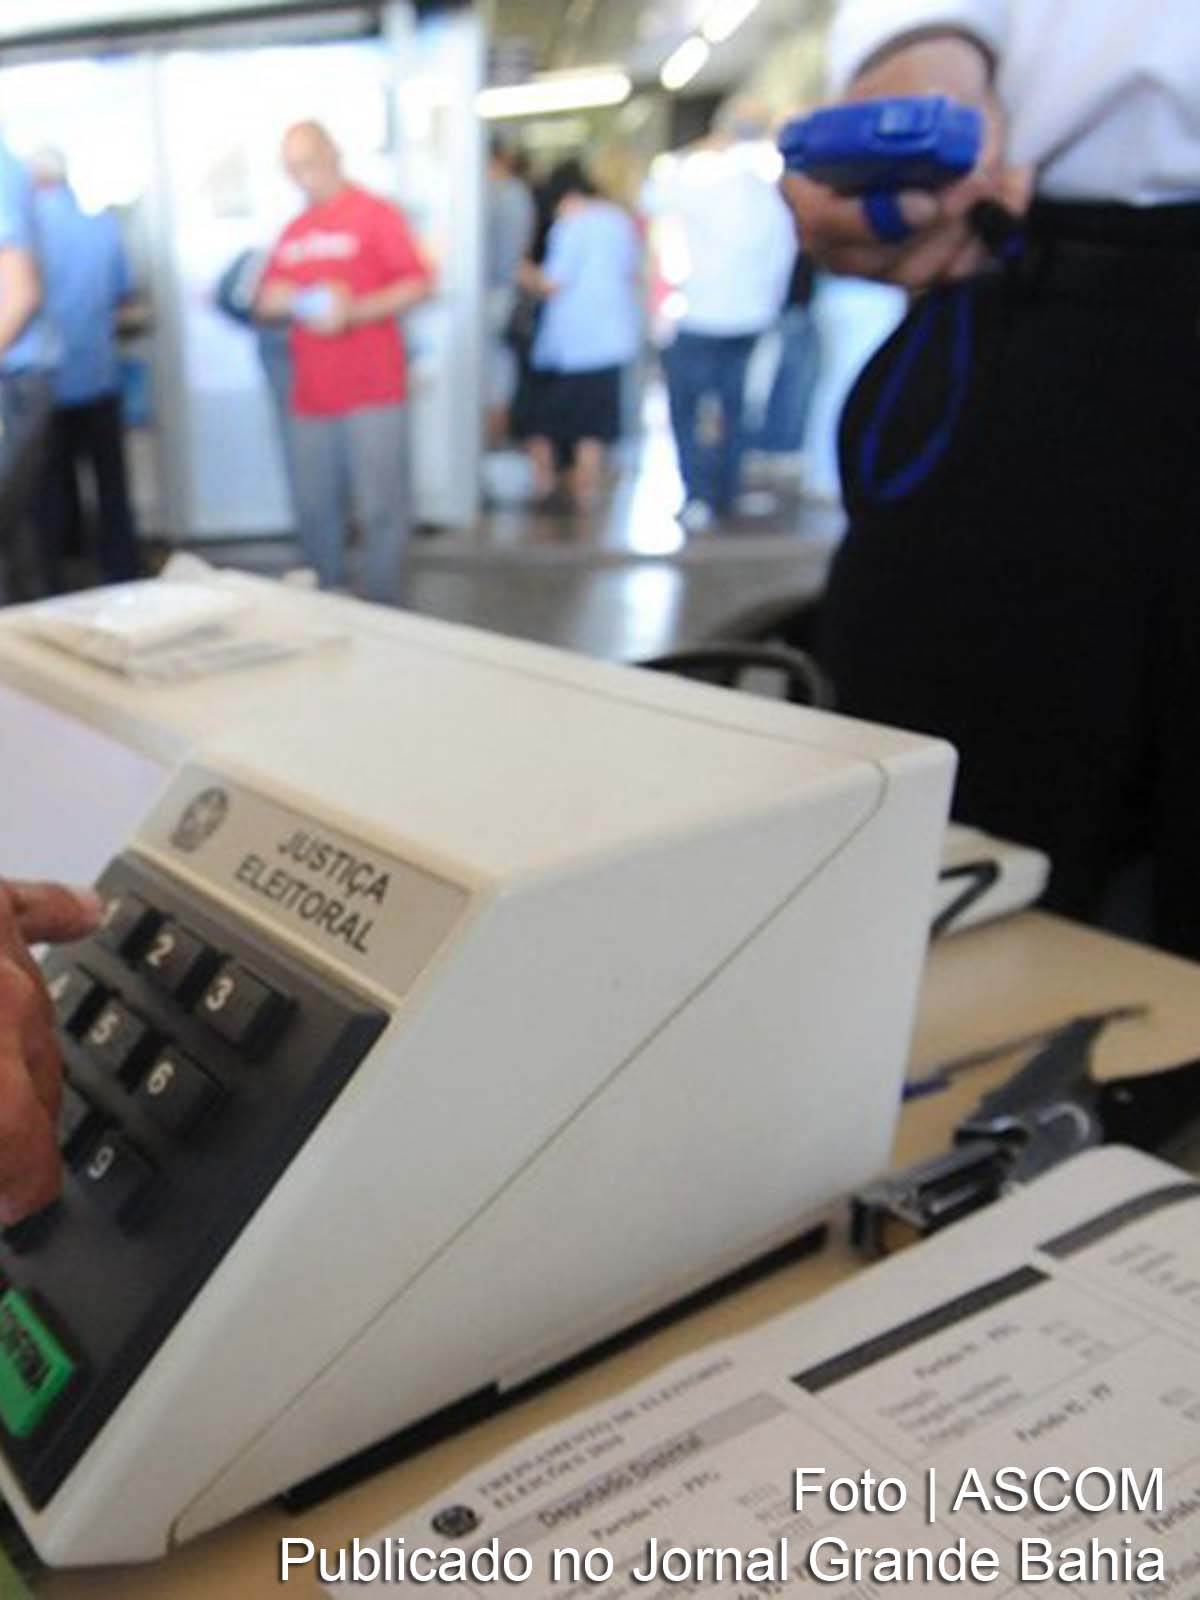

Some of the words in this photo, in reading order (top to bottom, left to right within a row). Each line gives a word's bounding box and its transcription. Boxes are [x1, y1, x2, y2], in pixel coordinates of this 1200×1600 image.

[234, 853, 374, 954] ELEITORAL
[277, 829, 390, 905] JUSTIÇA
[146, 932, 175, 967] 2
[206, 976, 236, 1011] 3
[91, 1013, 119, 1044] 5
[147, 1061, 175, 1096] 6
[87, 1146, 115, 1179] 9
